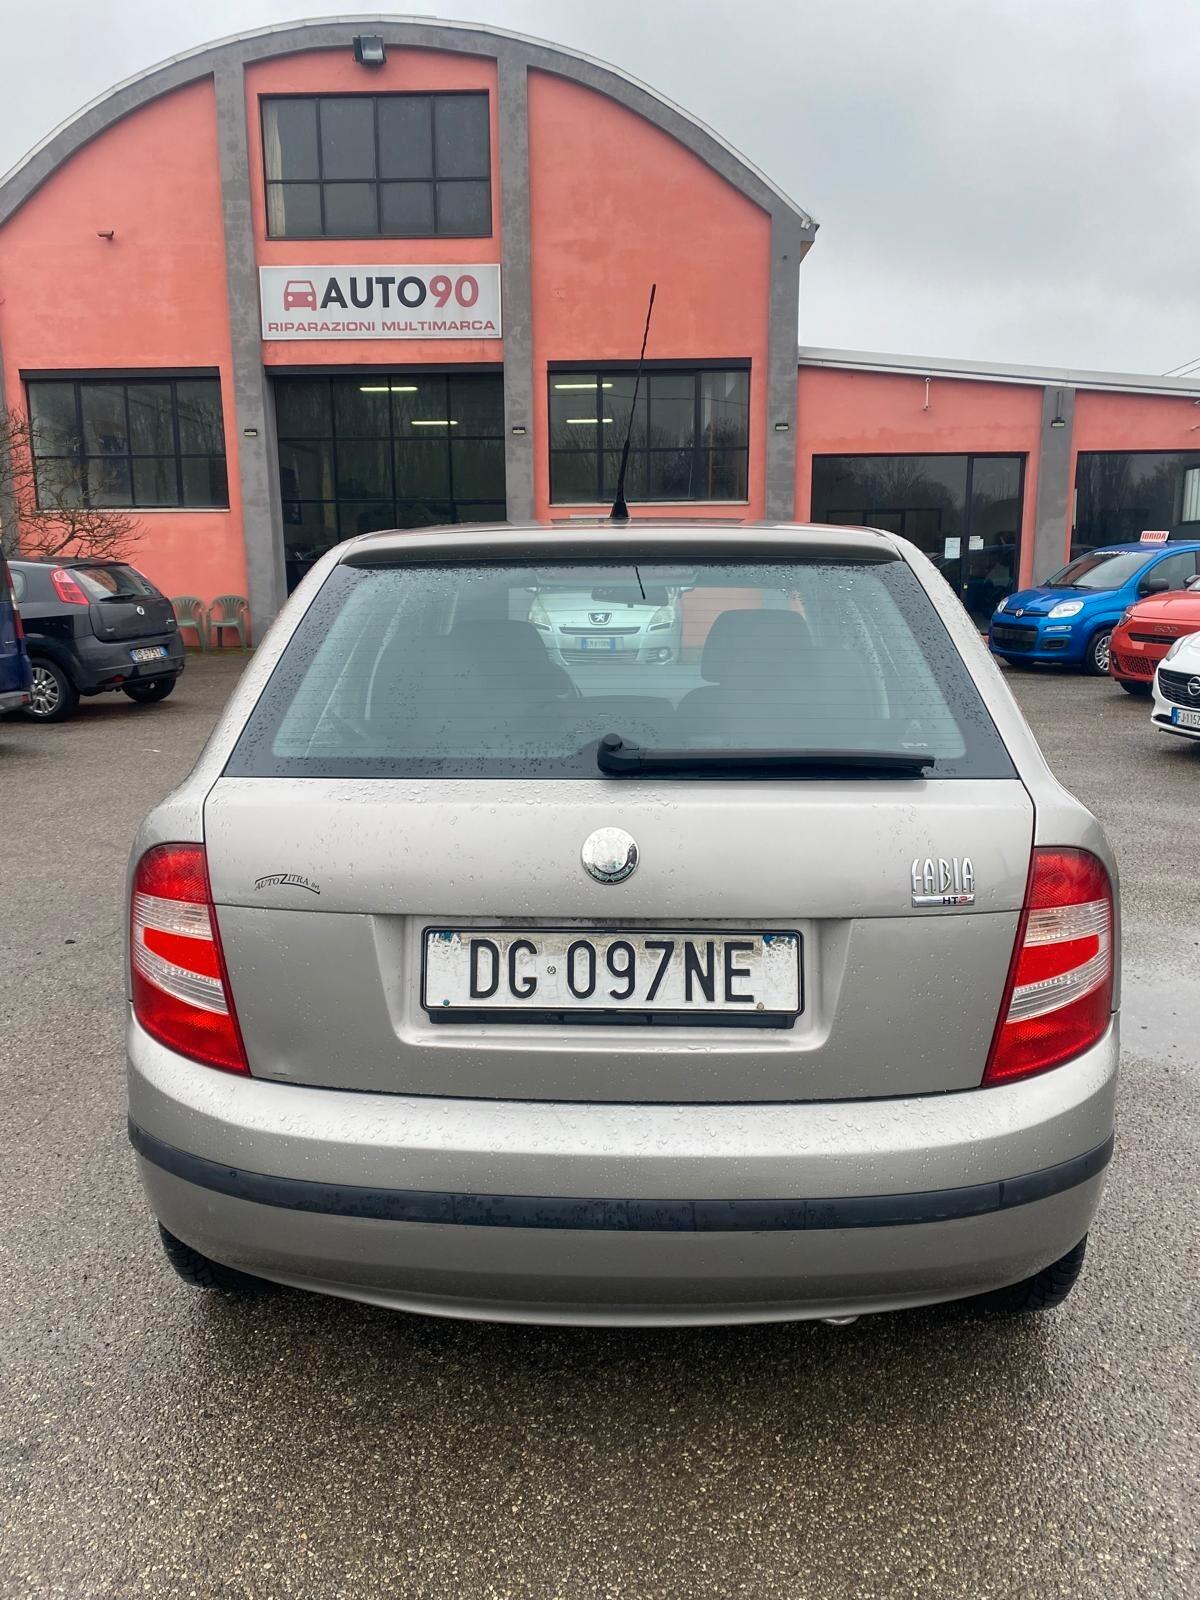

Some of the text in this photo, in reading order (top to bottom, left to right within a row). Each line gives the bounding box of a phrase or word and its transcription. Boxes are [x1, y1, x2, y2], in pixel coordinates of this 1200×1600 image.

[320, 274, 479, 309] AUTO90
[268, 320, 496, 333] RIPARAZIONI MULTIMARCA
[1142, 532, 1167, 540] IBRIDA
[911, 858, 975, 894] FABIA
